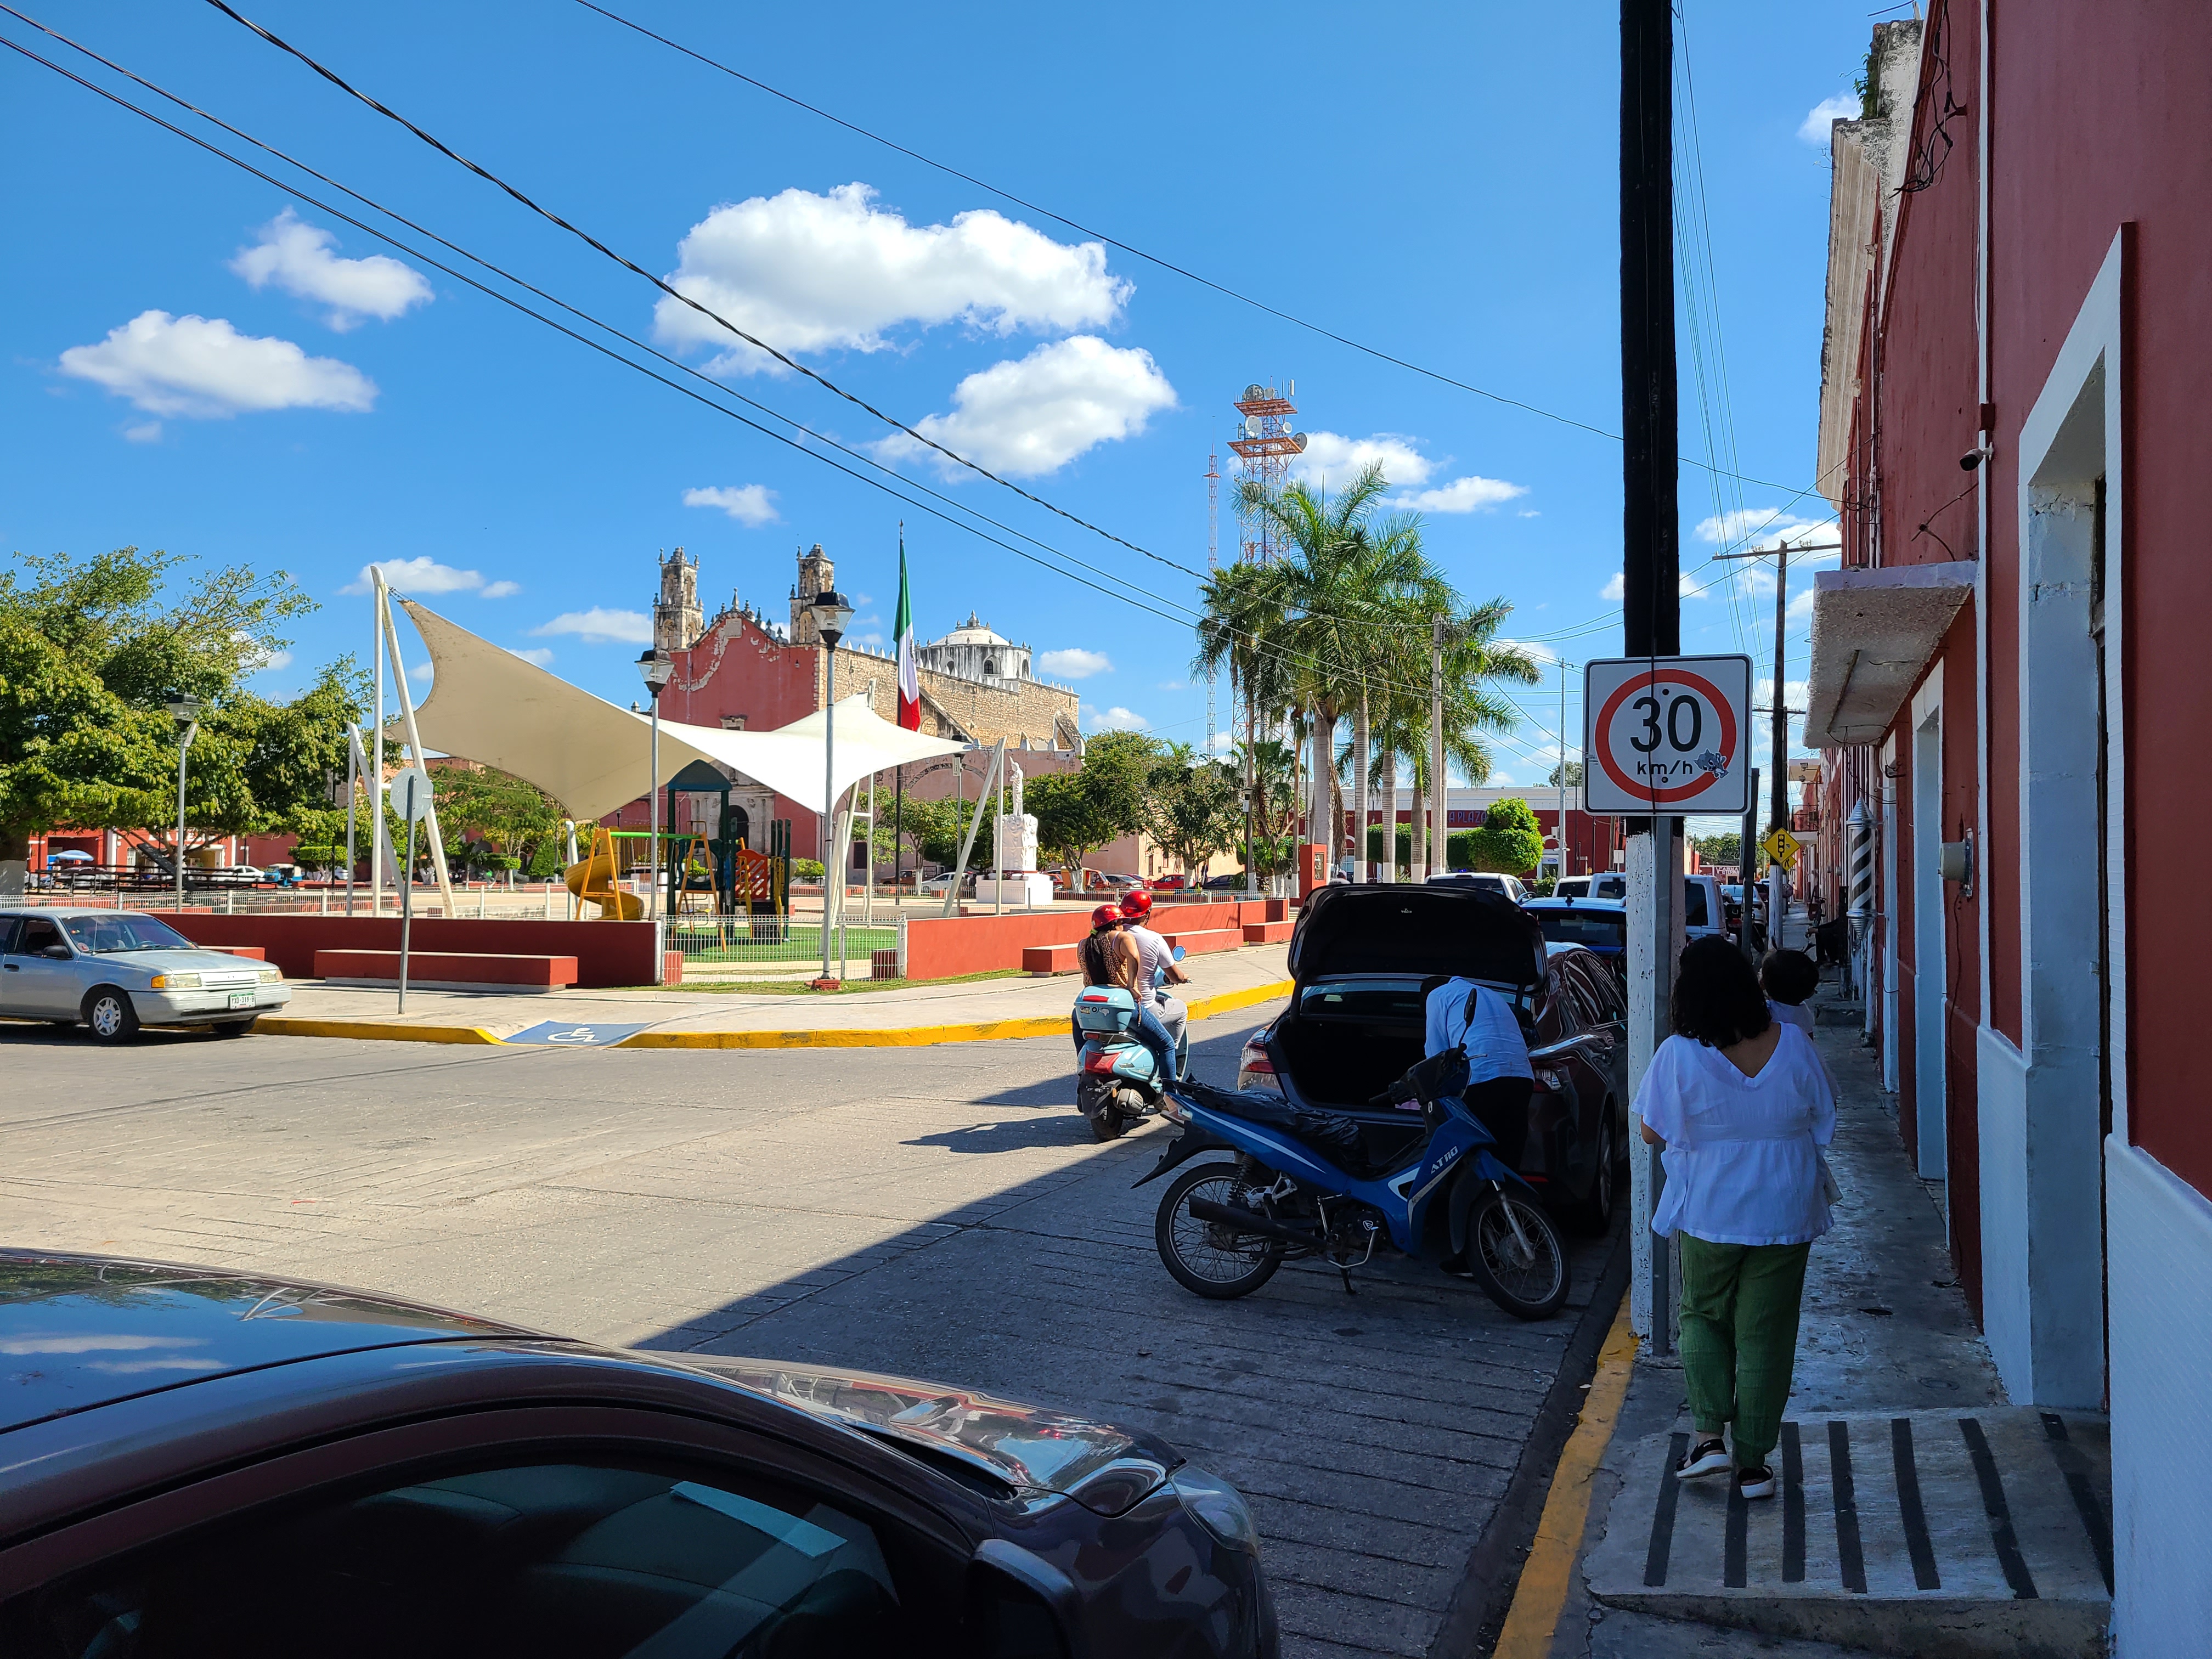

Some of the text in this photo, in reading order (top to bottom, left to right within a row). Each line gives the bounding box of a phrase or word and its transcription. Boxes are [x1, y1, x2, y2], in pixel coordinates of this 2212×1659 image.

[1630, 695, 1702, 753] 30
[1637, 760, 1693, 775] km/h
[1458, 811, 1487, 823] PLAZA
